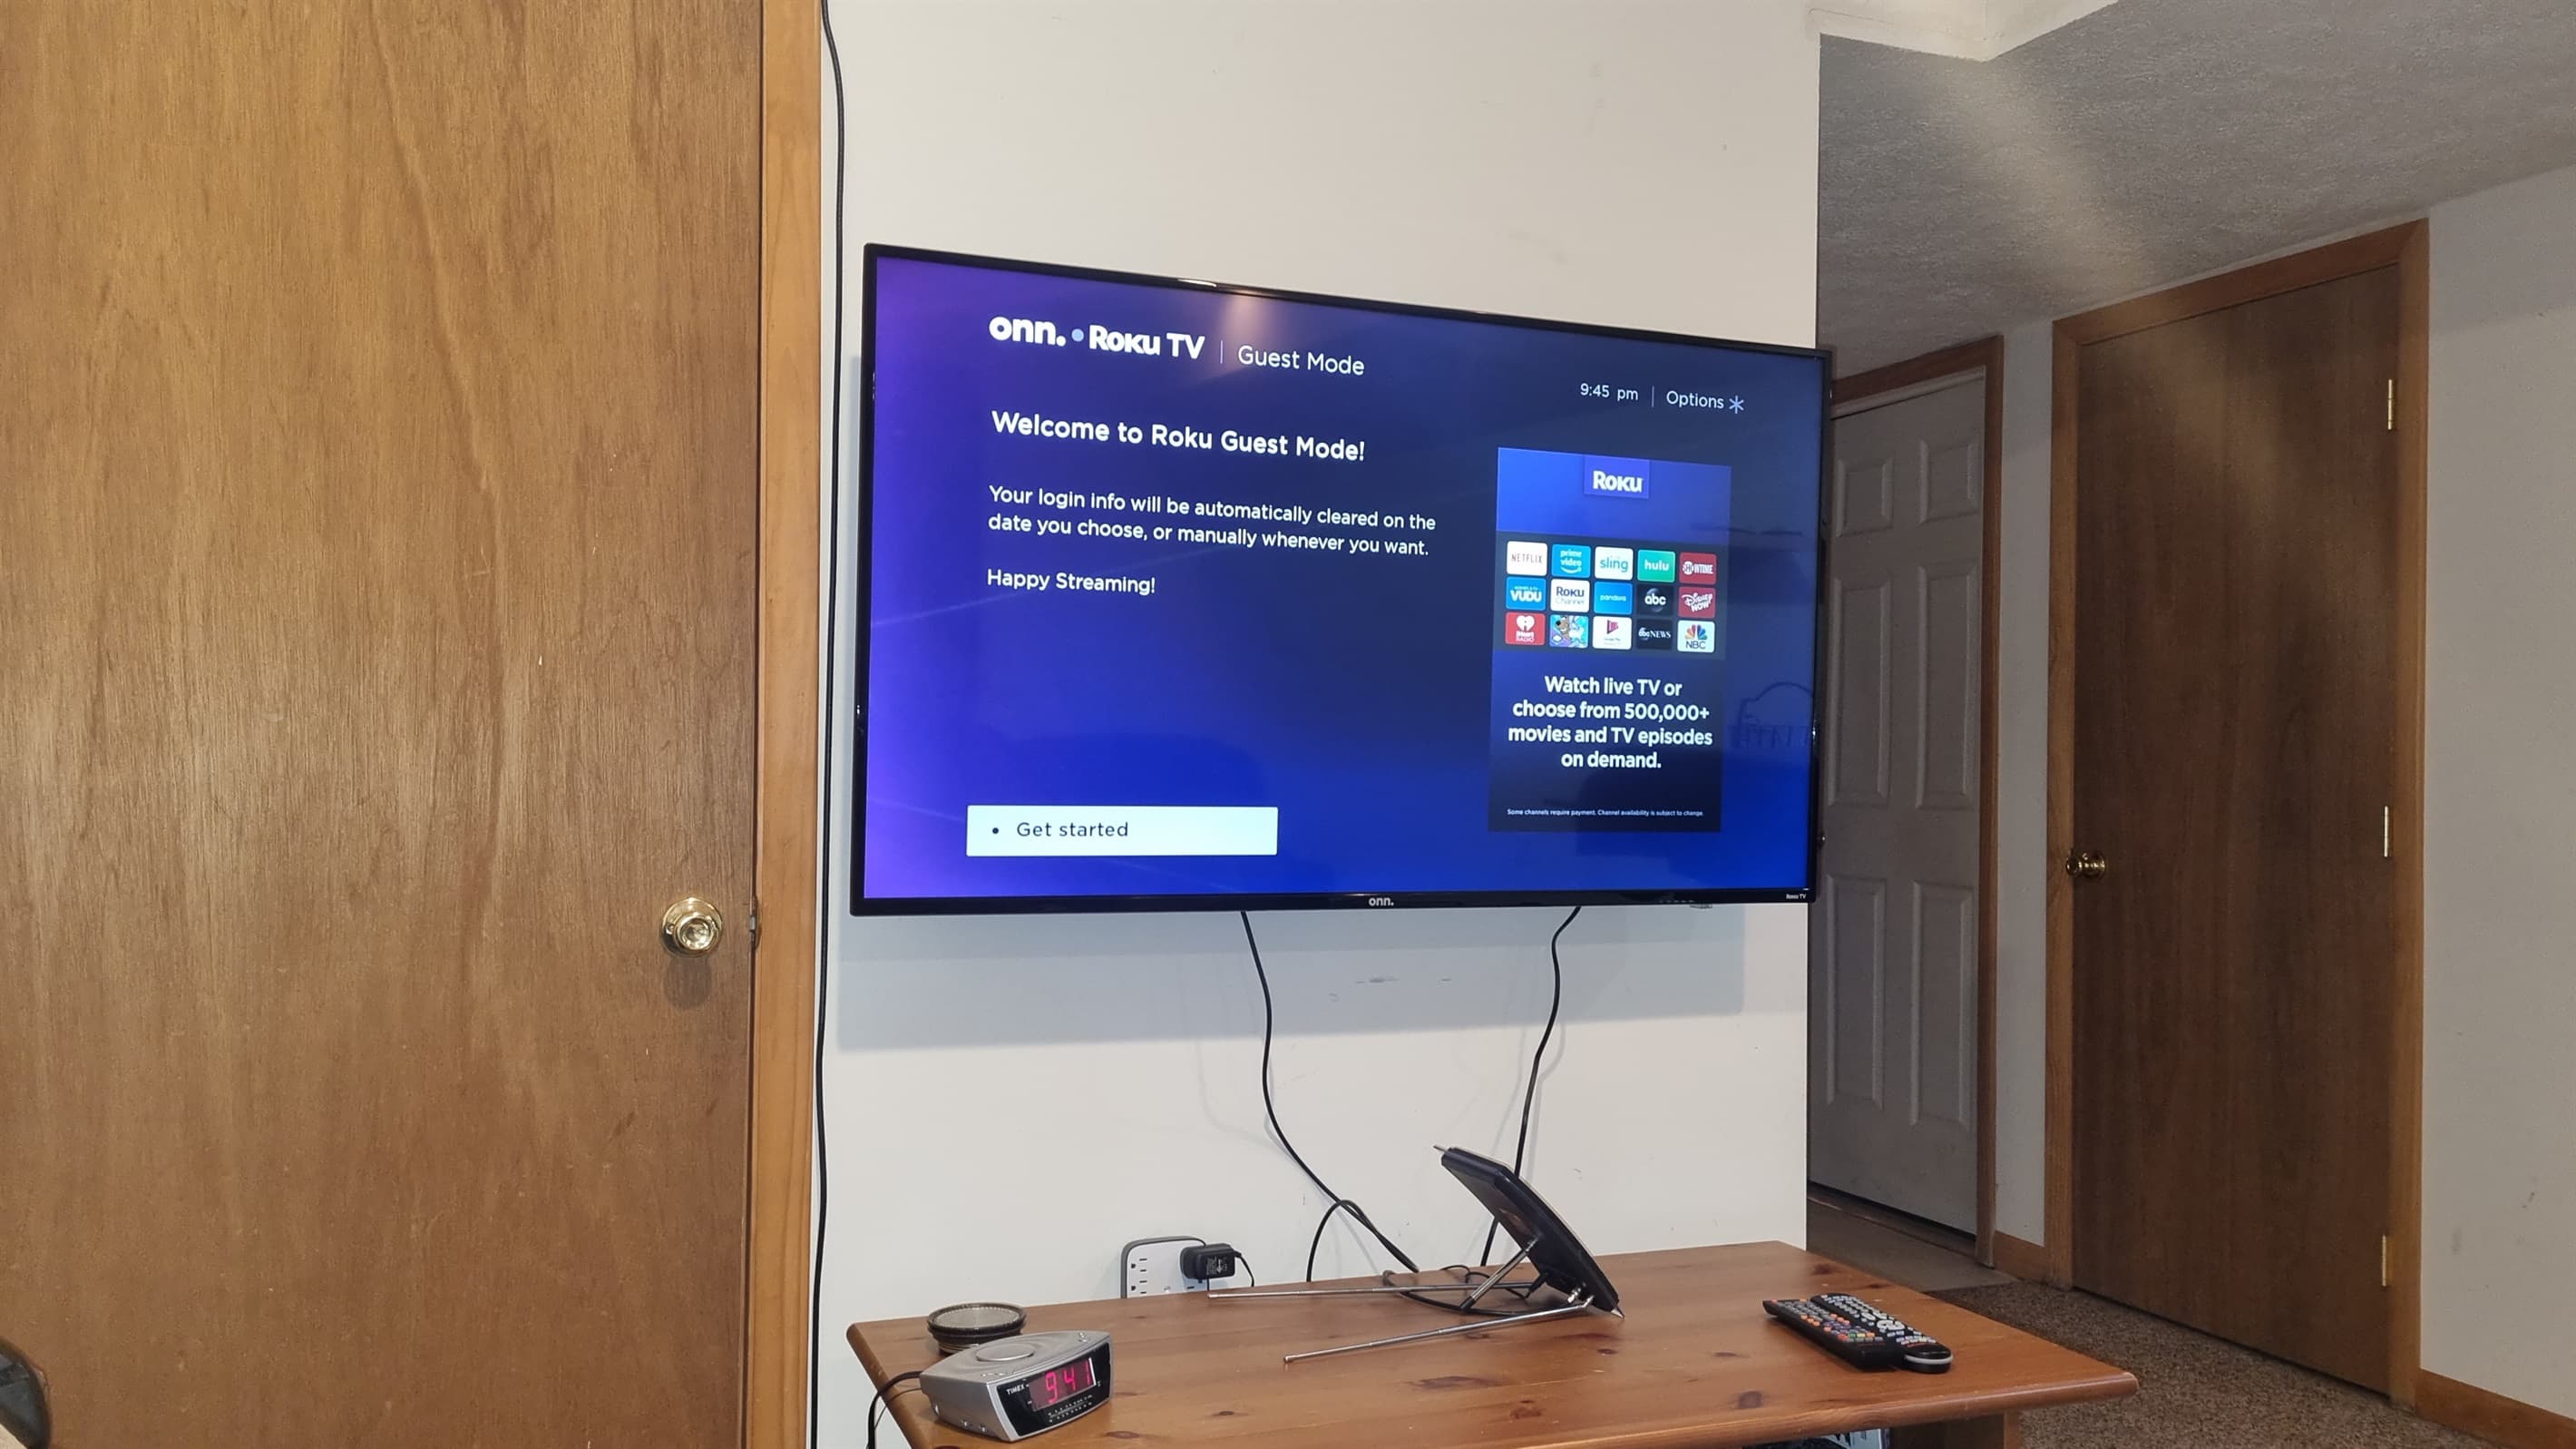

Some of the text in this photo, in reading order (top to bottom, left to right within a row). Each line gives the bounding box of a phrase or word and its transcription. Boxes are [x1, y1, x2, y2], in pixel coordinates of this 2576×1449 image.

[989, 316, 1205, 359] onn. Roku TV
[1238, 345, 1365, 376] Guest Mode
[1580, 383, 1638, 401] 9:45 pm
[1666, 390, 1724, 409] Options
[991, 410, 1365, 462] Welcome to Roku Guest Mode!
[1593, 470, 1643, 492] Roku
[989, 485, 1436, 530] Your login info will be automatically cleared on the
[989, 514, 1429, 556] date you choose, or manually whenever you want.
[1511, 553, 1543, 563] NETFLIX
[1560, 550, 1583, 558] prime
[1561, 557, 1583, 567] video
[1600, 558, 1629, 573] sling
[1644, 561, 1669, 571] hulu
[988, 569, 1156, 595] Happy Streaming!
[1510, 590, 1542, 602] VUDU
[1644, 593, 1666, 605] abc
[1685, 641, 1706, 650] NBC
[1545, 676, 1683, 696] Watch live TV or
[1513, 700, 1710, 722] choose from 500,000+
[1508, 725, 1712, 747] movies and TV episodes
[1561, 751, 1662, 769] on demand.
[1550, 808, 1570, 817] require
[1016, 821, 1129, 837] Get started
[1369, 896, 1394, 906] onn.
[1006, 1384, 1025, 1395] TIMEX
